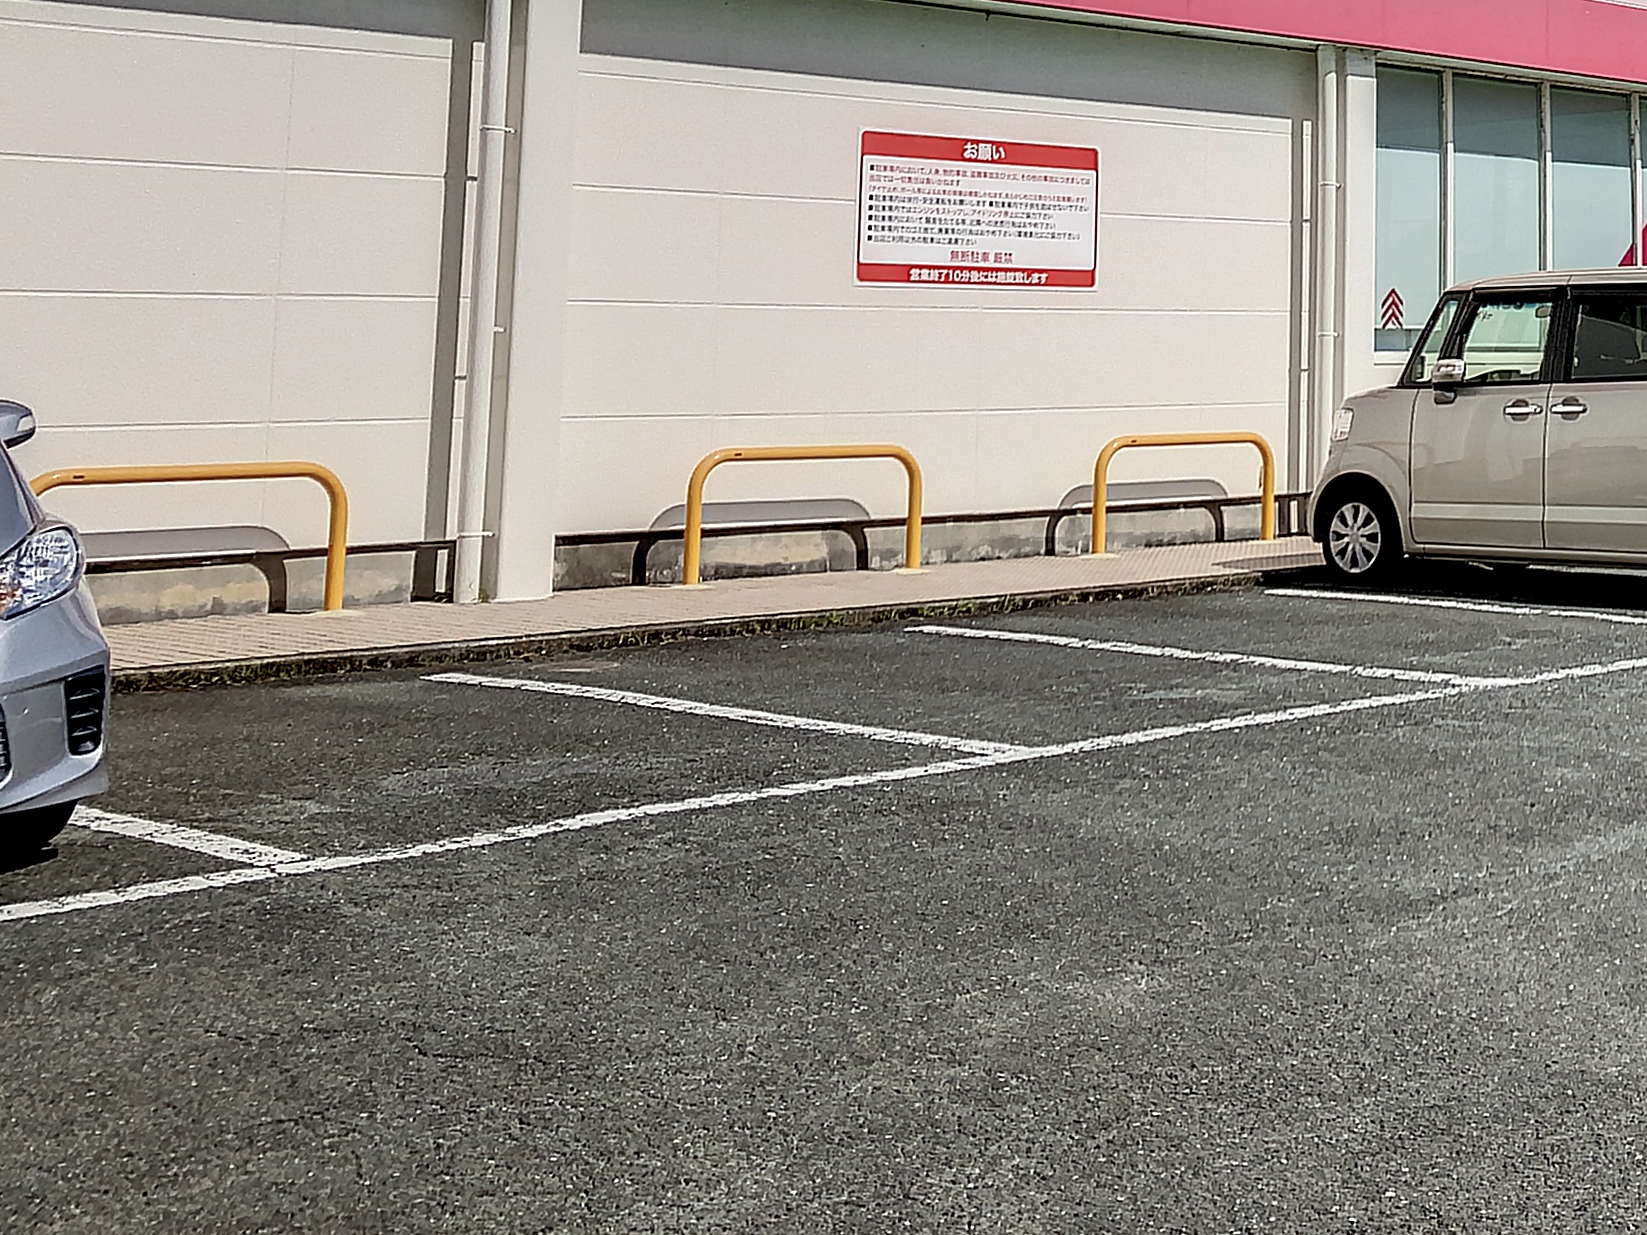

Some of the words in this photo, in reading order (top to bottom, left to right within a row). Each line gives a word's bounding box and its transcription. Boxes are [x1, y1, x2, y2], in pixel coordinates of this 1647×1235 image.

[963, 141, 1006, 161] お願い
[950, 250, 990, 263] 無断駐車
